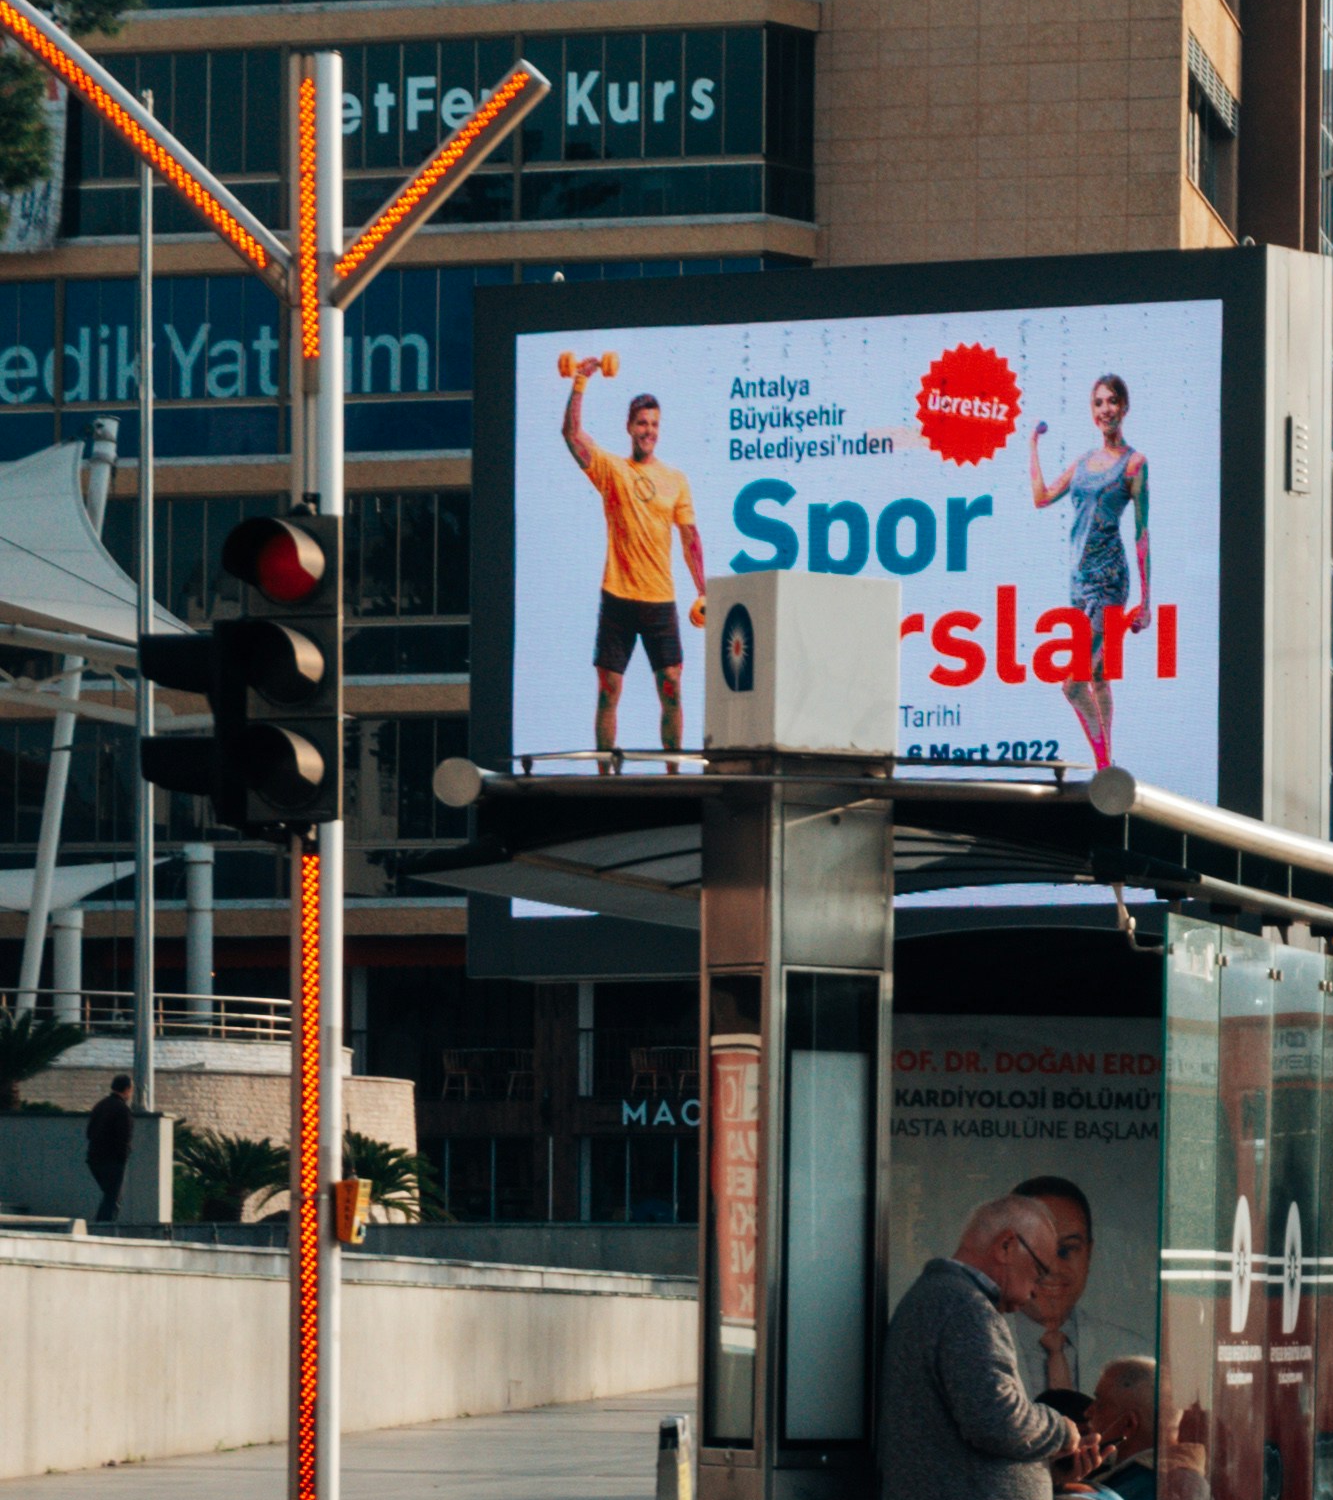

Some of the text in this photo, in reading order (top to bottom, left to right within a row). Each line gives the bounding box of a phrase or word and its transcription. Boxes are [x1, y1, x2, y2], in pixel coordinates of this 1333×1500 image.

[342, 70, 715, 134] etFe Kurs
[730, 374, 810, 402] Antalya
[730, 403, 846, 433] Büyükşehir
[928, 388, 1010, 422] ücretsiz
[730, 431, 893, 463] Belediyesi'nden
[730, 478, 994, 577] Spor
[899, 703, 961, 729] Tarihi
[930, 743, 990, 760] Mart
[996, 739, 1060, 761] 2022
[893, 1051, 938, 1073] OF.
[944, 1051, 988, 1074] DR.
[995, 1046, 1096, 1075] DOĞAN
[894, 1085, 1046, 1109] KARDİYOLOJİ
[953, 1116, 1068, 1139] KABULÜNE
